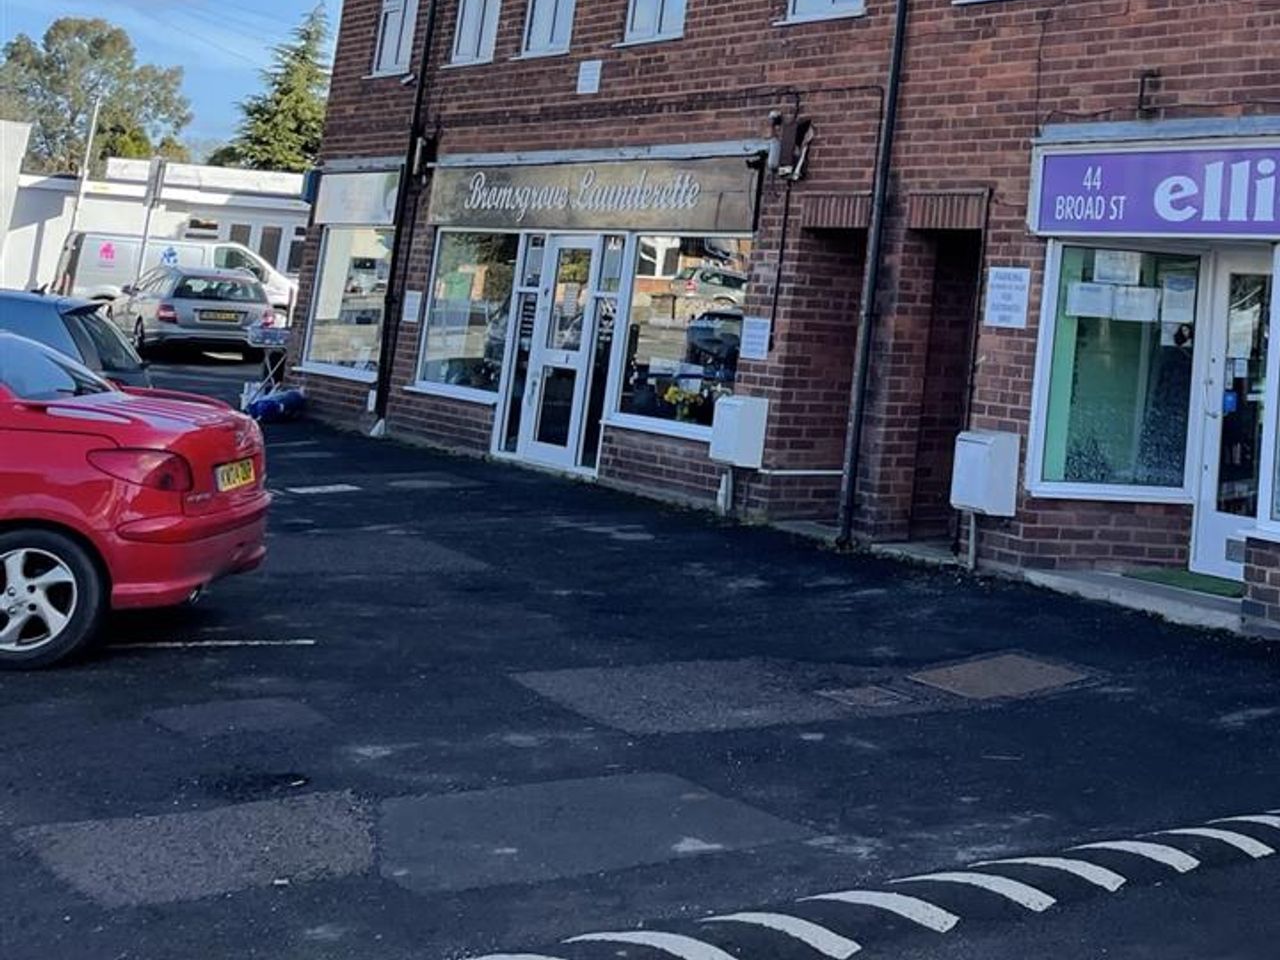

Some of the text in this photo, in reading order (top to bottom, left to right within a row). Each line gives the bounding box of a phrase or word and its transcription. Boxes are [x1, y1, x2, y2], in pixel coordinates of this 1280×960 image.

[1083, 166, 1103, 190] 44
[465, 167, 702, 223] Bromsgrove Launderette
[1055, 196, 1127, 221] BROAD ST
